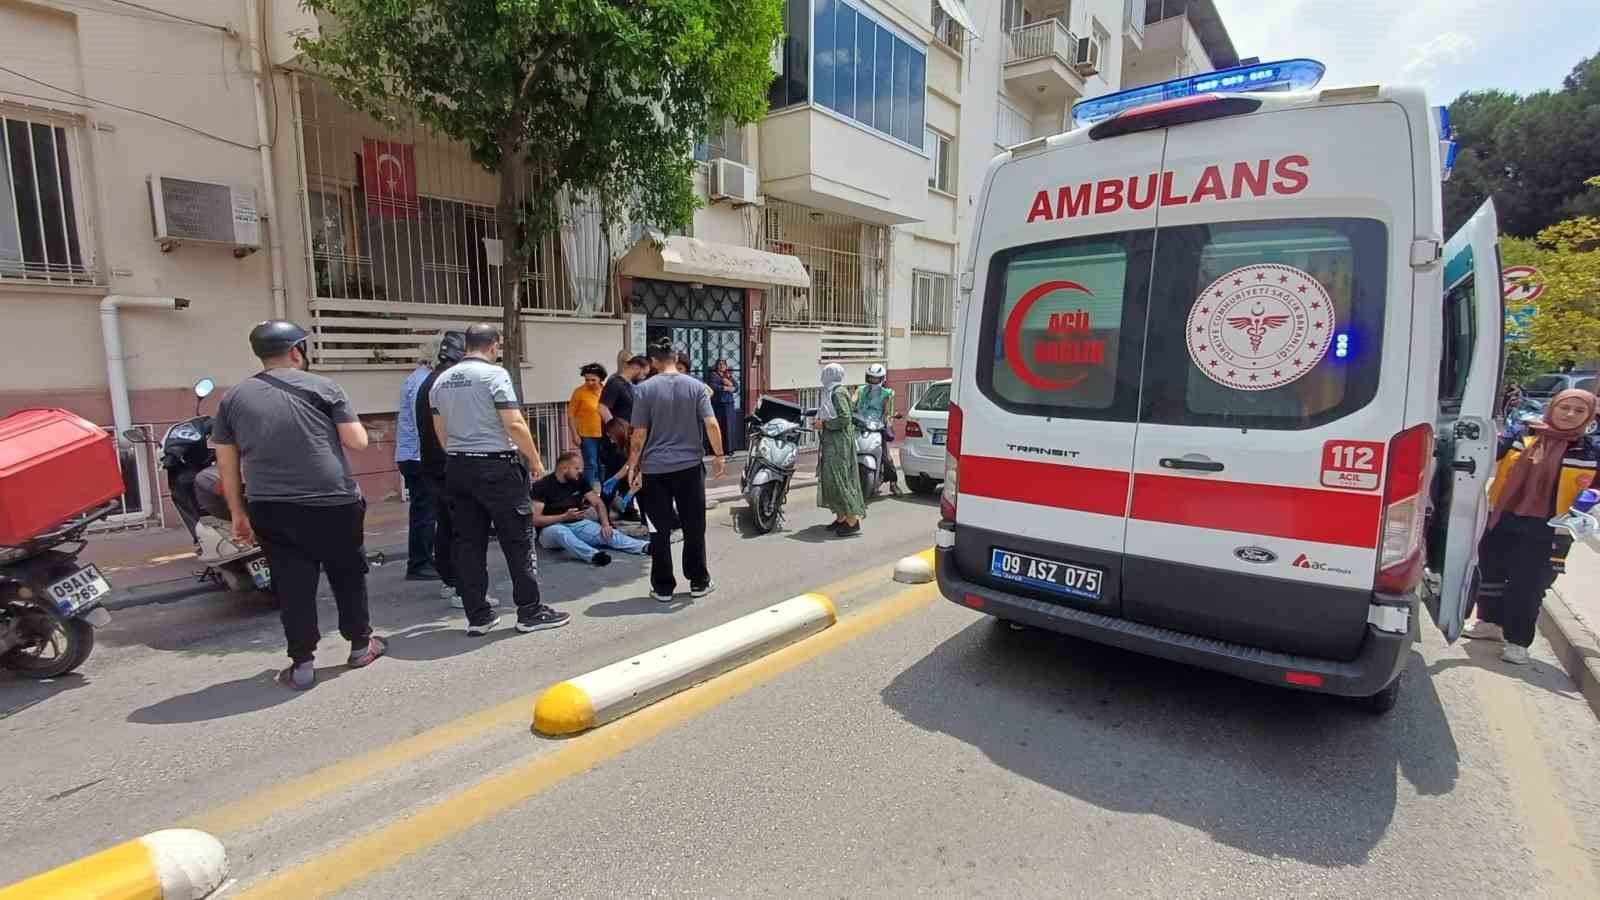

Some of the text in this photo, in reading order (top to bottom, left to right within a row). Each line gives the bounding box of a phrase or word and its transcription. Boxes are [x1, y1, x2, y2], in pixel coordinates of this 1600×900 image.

[1026, 154, 1310, 223] AMBULANS
[1006, 443, 1080, 458] TRANSIT
[1331, 446, 1374, 470] 112
[1002, 554, 1020, 574] 09
[1027, 560, 1057, 583] ASZ
[1065, 568, 1096, 591] 075
